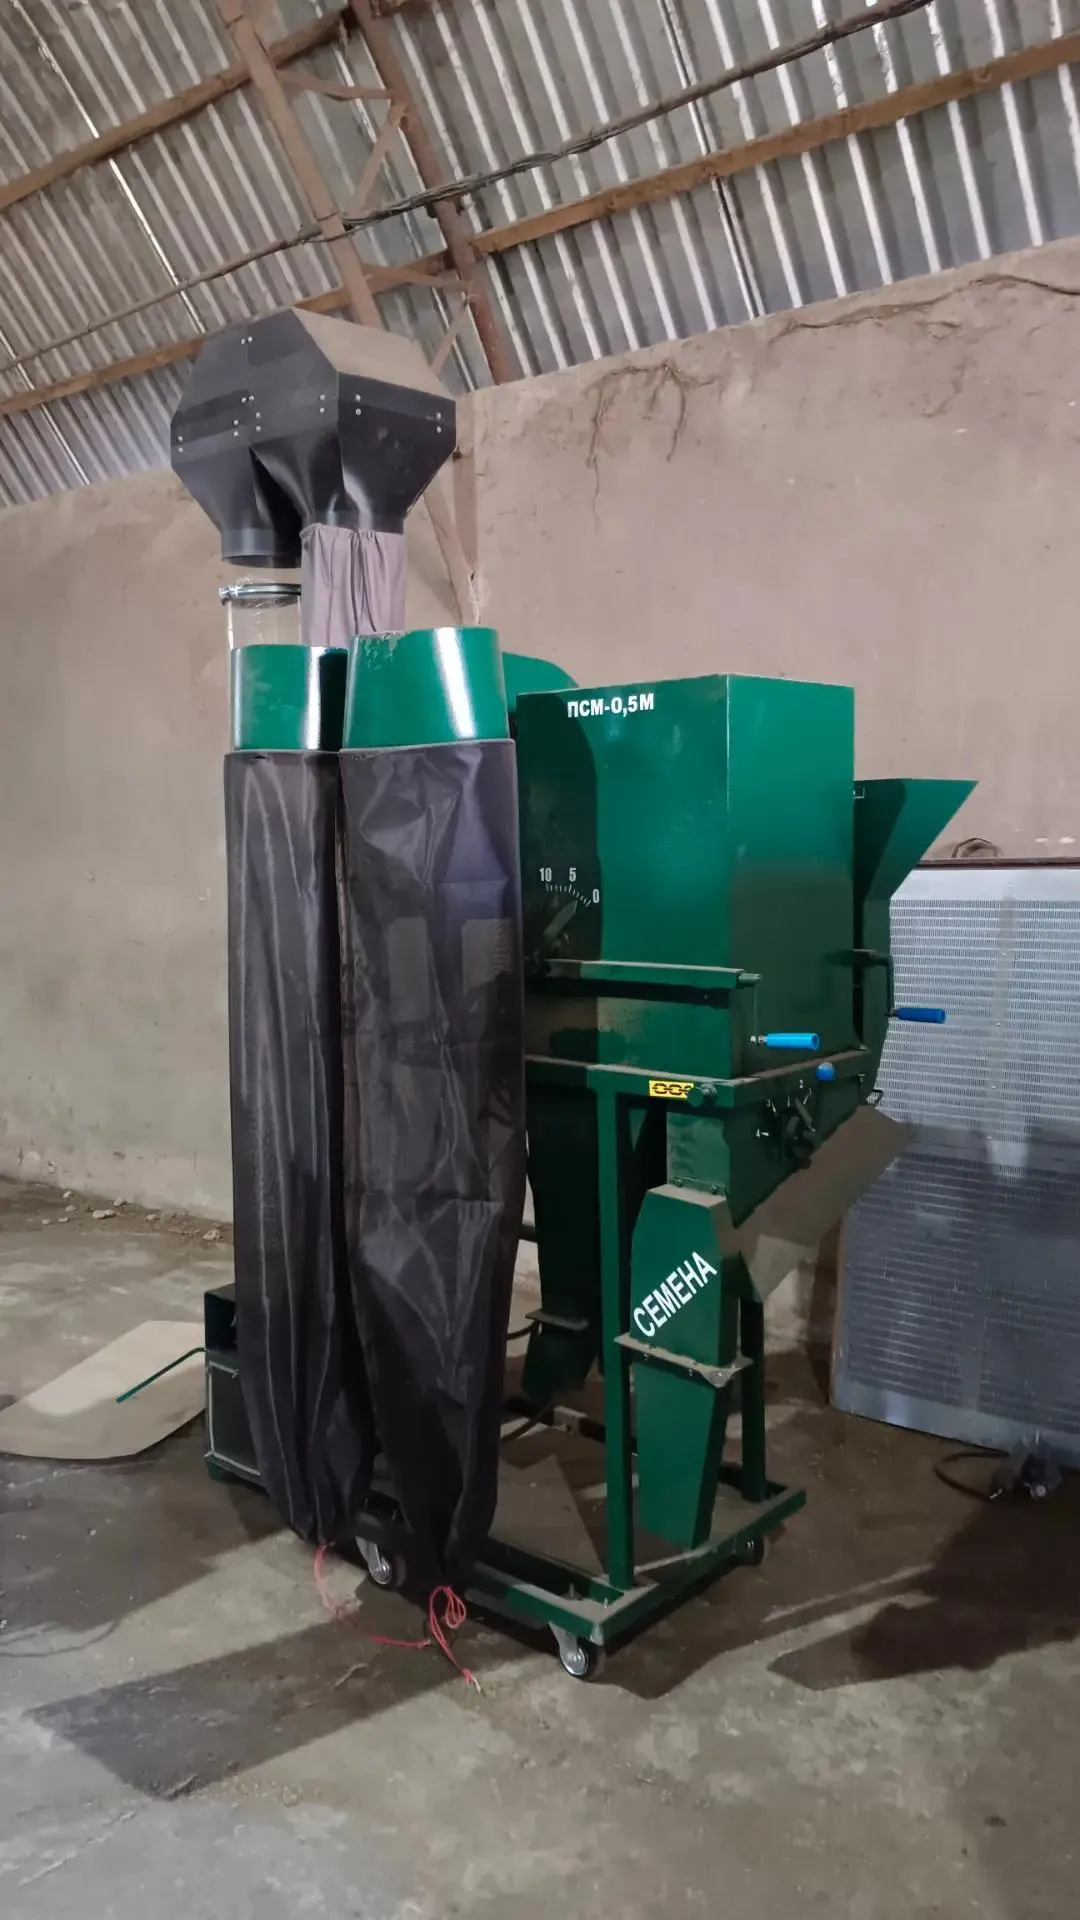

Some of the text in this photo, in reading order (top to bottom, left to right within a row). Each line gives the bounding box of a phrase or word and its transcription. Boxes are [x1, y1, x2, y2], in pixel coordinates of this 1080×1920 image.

[567, 693, 654, 718] ПСМ-0,5М
[539, 867, 577, 882] 10 5
[592, 888, 600, 903] 0
[633, 1251, 718, 1337] СЕМЕНА
